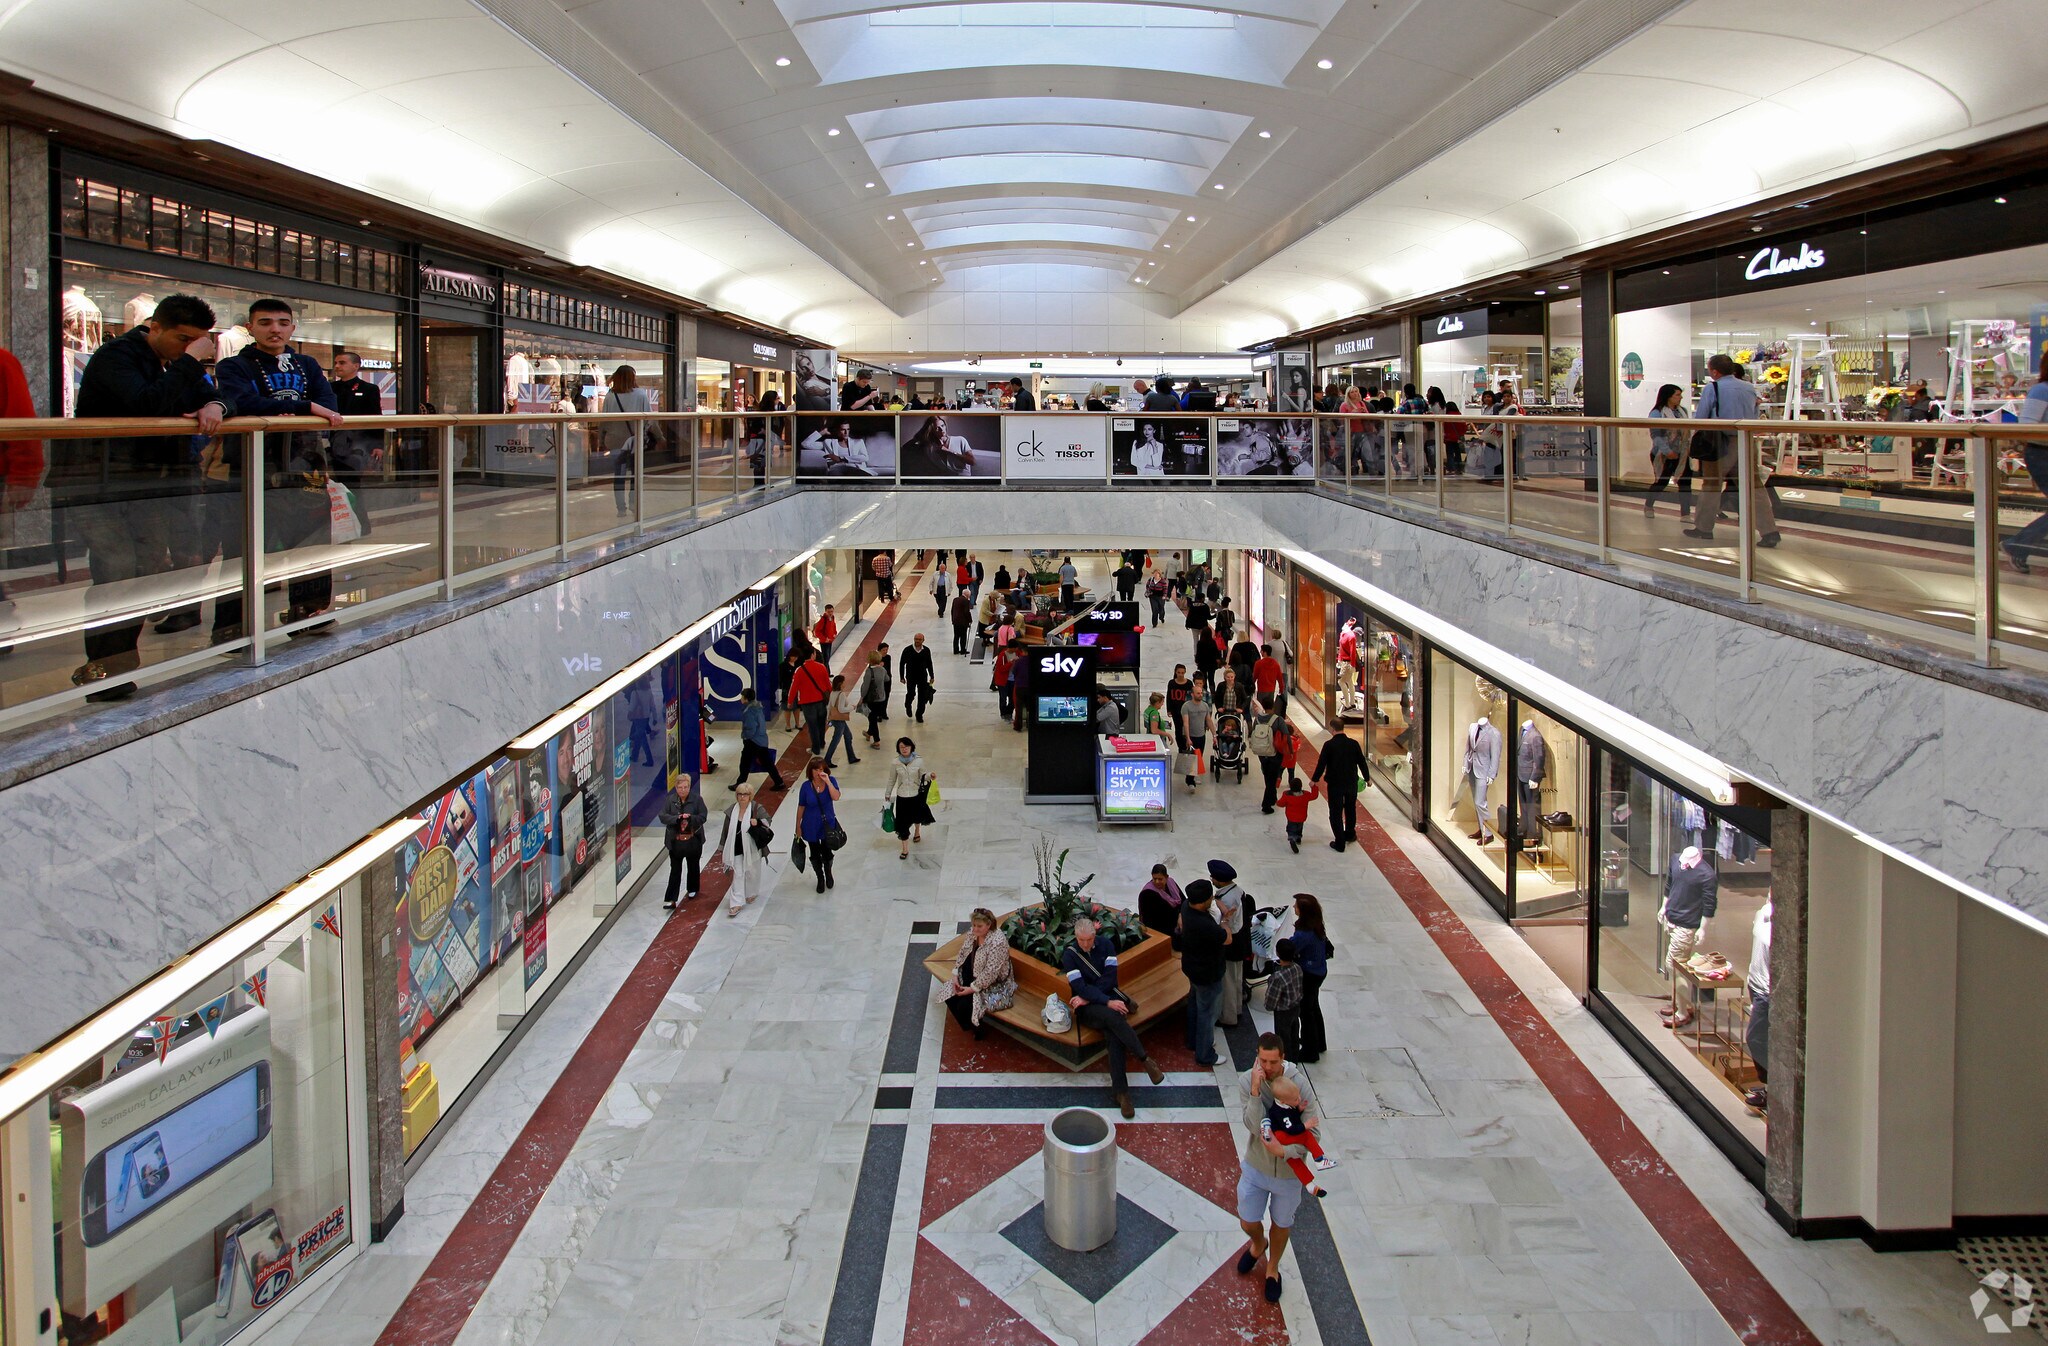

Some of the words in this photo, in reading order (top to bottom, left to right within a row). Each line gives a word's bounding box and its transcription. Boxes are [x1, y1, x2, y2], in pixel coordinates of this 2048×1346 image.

[1745, 243, 1825, 280] Clarks
[426, 274, 495, 302] ALLSAINTS
[1437, 317, 1463, 335] Clarks
[753, 343, 777, 357] GOLDSMITHS
[1335, 341, 1356, 355] FRASER
[1356, 337, 1374, 352] HART
[1017, 430, 1045, 457] ck
[1055, 450, 1095, 458] TISSOT
[1090, 611, 1108, 621] Sky
[1109, 611, 1123, 620] 3D
[1041, 652, 1084, 677] sky
[667, 700, 678, 717] HALF
[574, 745, 593, 774] BOOK
[1111, 766, 1133, 775] Half
[1134, 766, 1160, 778] price
[577, 763, 592, 787] CLUB
[1110, 777, 1137, 790] Sky
[1140, 777, 1161, 788] TV
[526, 815, 540, 831] NOW
[493, 843, 511, 873] BEST
[416, 854, 450, 901] BEST
[420, 882, 448, 922] DAD
[528, 955, 545, 979] kobo
[101, 1098, 147, 1129] Samsung
[149, 1063, 207, 1101] GALAXY
[1283, 1116, 1292, 1129] 3
[297, 1205, 344, 1245] UPGRADE
[298, 1214, 344, 1257] PRICE
[299, 1224, 345, 1263] PROMISE
[257, 1255, 291, 1283] phones
